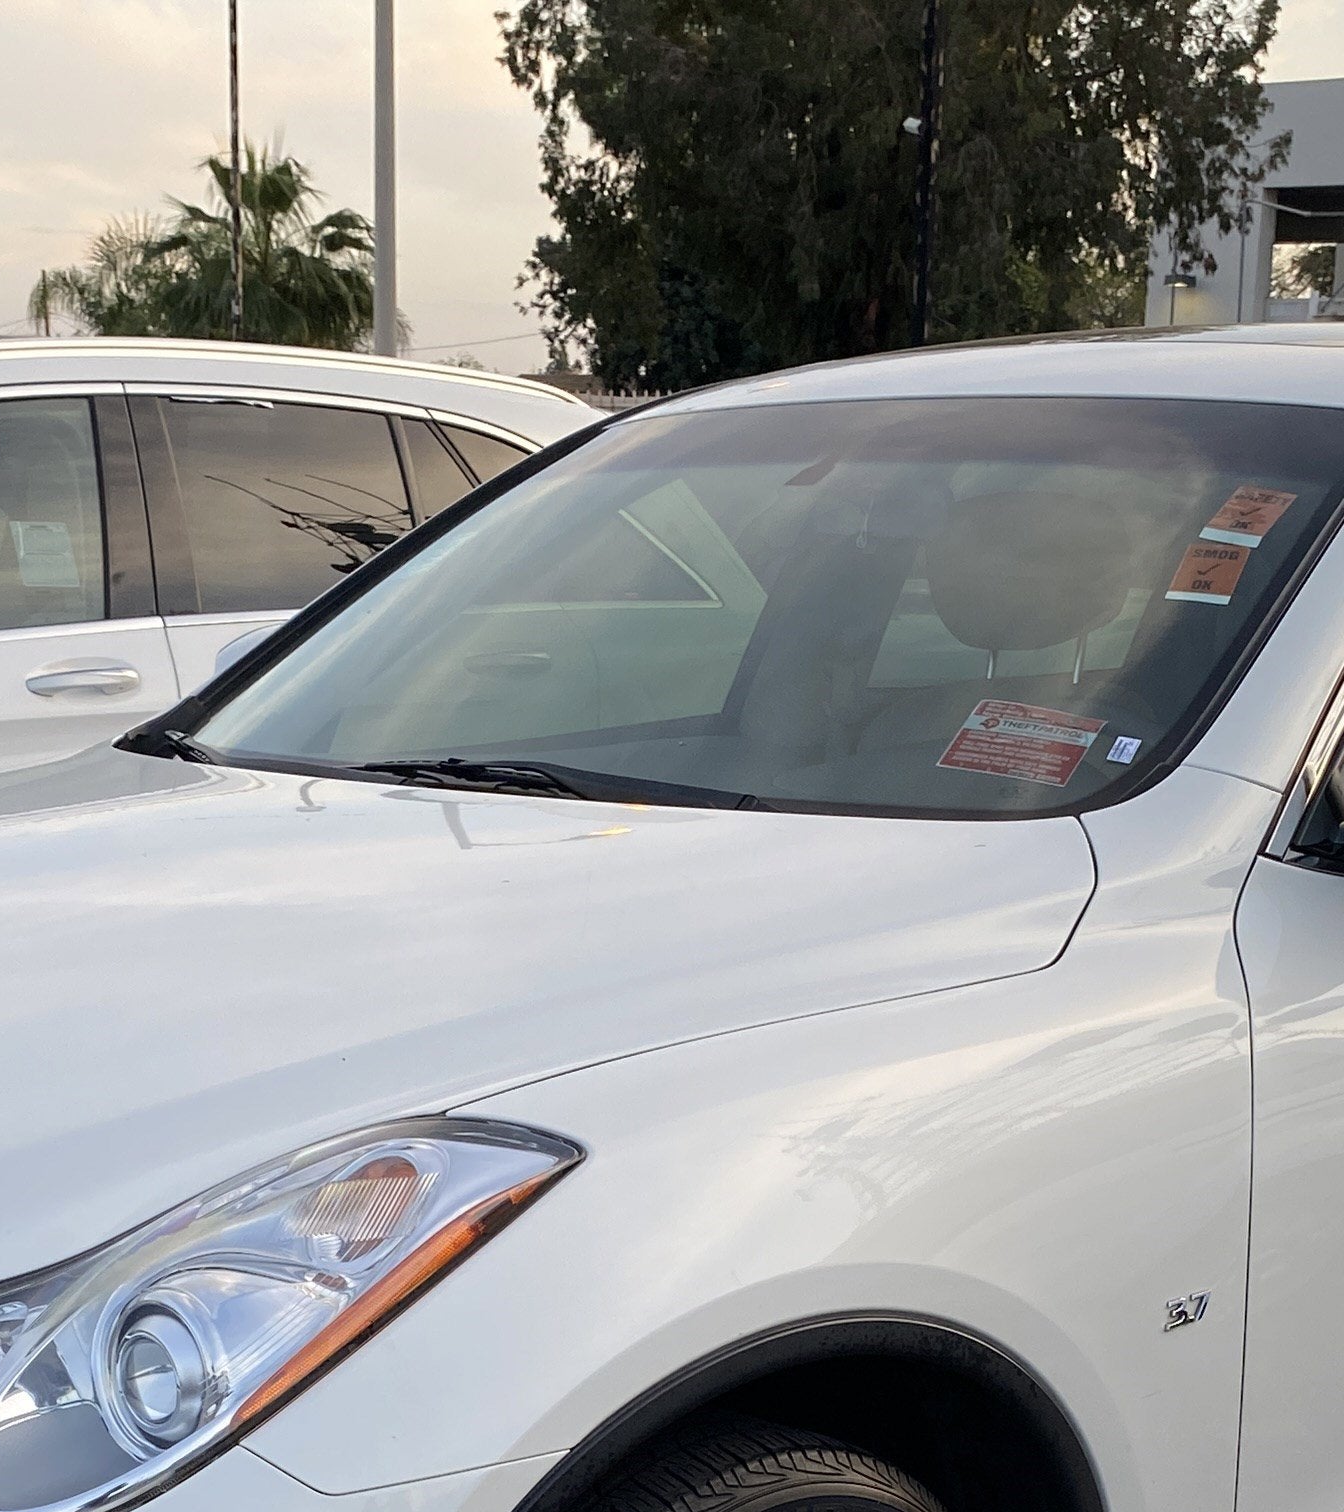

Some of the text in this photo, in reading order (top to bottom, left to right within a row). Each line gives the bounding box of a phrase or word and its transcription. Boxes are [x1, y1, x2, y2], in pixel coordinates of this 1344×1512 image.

[1192, 549, 1240, 561] SMOG
[1191, 579, 1214, 591] OK
[1163, 1288, 1212, 1332] 3.7
